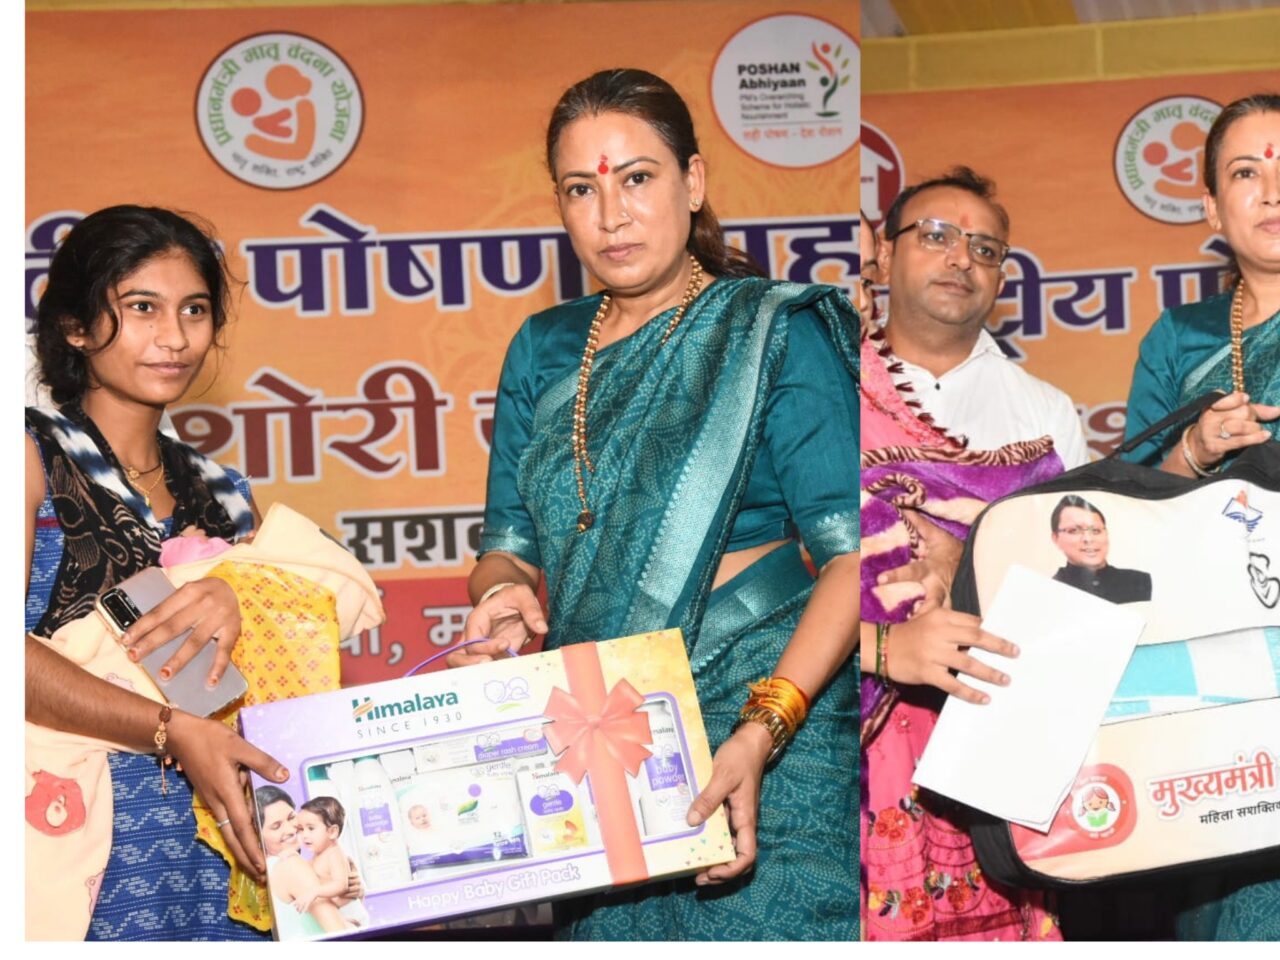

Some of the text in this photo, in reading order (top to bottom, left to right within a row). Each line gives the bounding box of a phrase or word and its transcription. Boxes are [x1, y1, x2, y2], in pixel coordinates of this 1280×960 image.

[242, 42, 281, 63] मातृ
[737, 62, 801, 75] POSHAN
[739, 77, 806, 91] Abhiyaan
[246, 209, 583, 312] पोषण
[352, 690, 459, 722] Himalaya
[357, 711, 463, 739] SINCE 1930
[517, 742, 539, 753] cream
[1151, 751, 1275, 817] मुख्यमंत्री
[1199, 807, 1234, 825] महिला
[407, 863, 581, 910] Happy Baby Gift Pack
